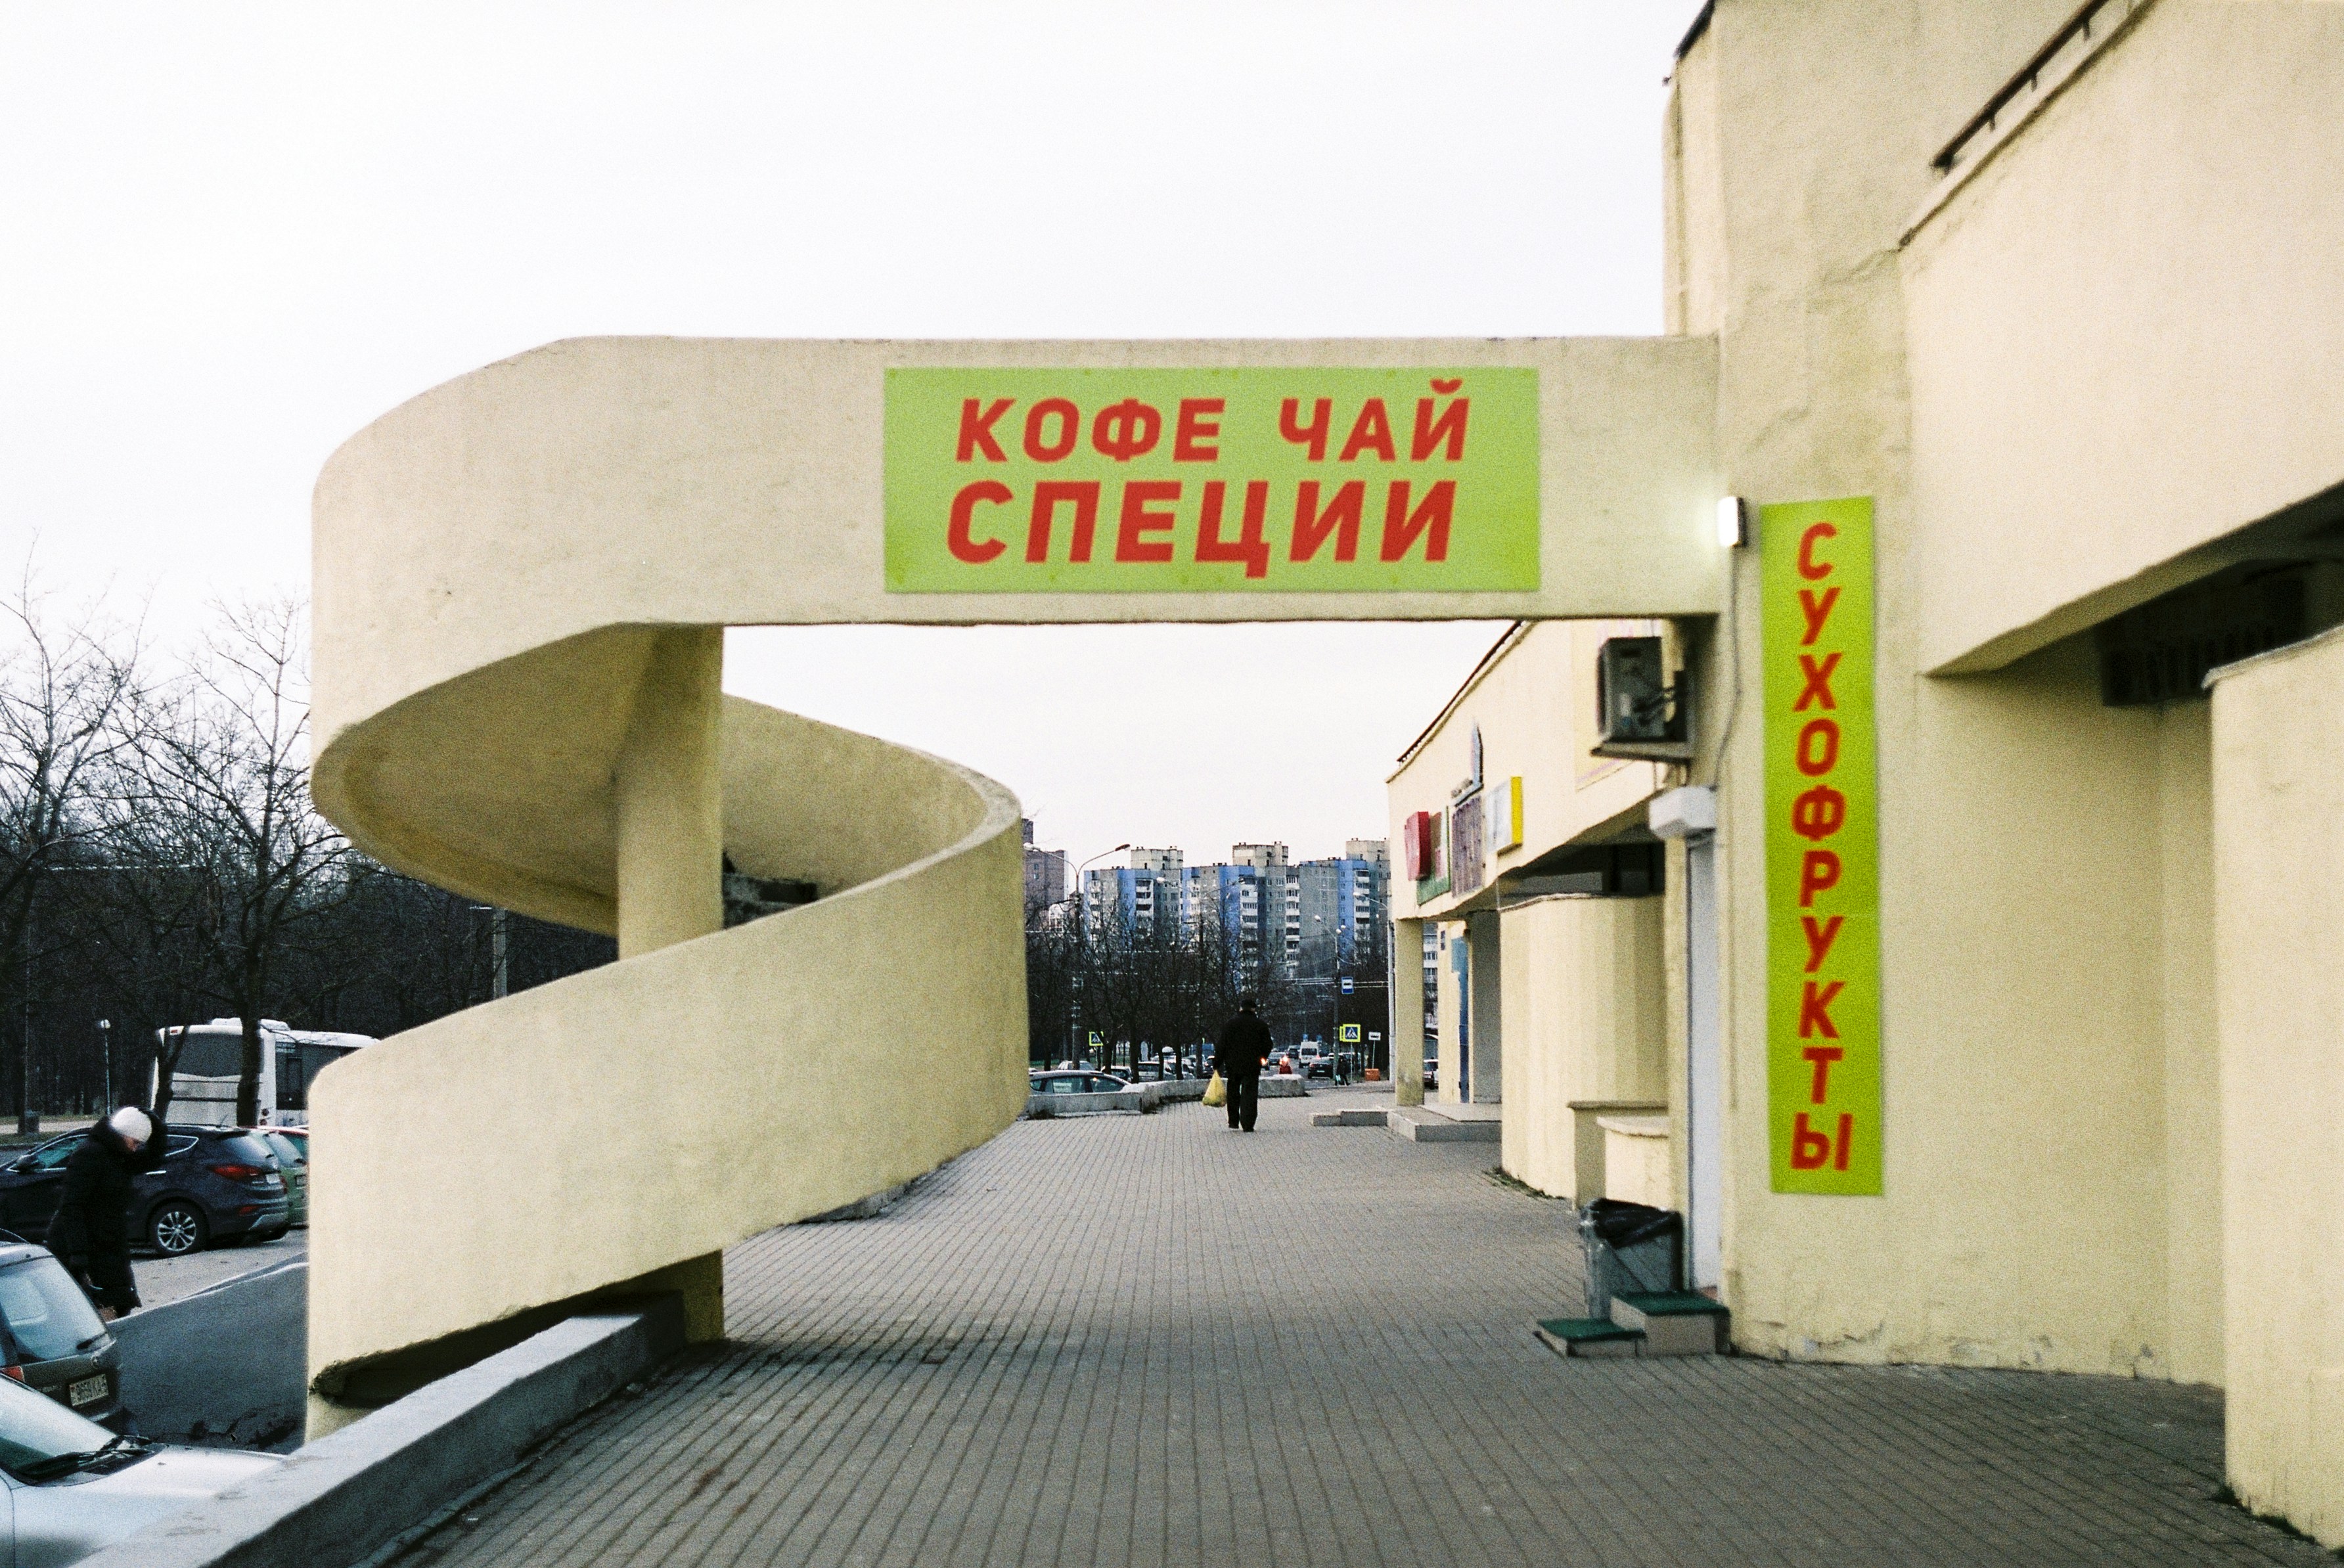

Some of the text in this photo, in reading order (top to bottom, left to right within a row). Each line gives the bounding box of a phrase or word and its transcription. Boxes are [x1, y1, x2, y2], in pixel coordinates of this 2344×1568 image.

[957, 378, 1470, 463] КОФЕ ЧАЙ
[947, 480, 1456, 579] СПЕЦИИ
[1791, 522, 1853, 1171] СУХОФРУКТЫ
